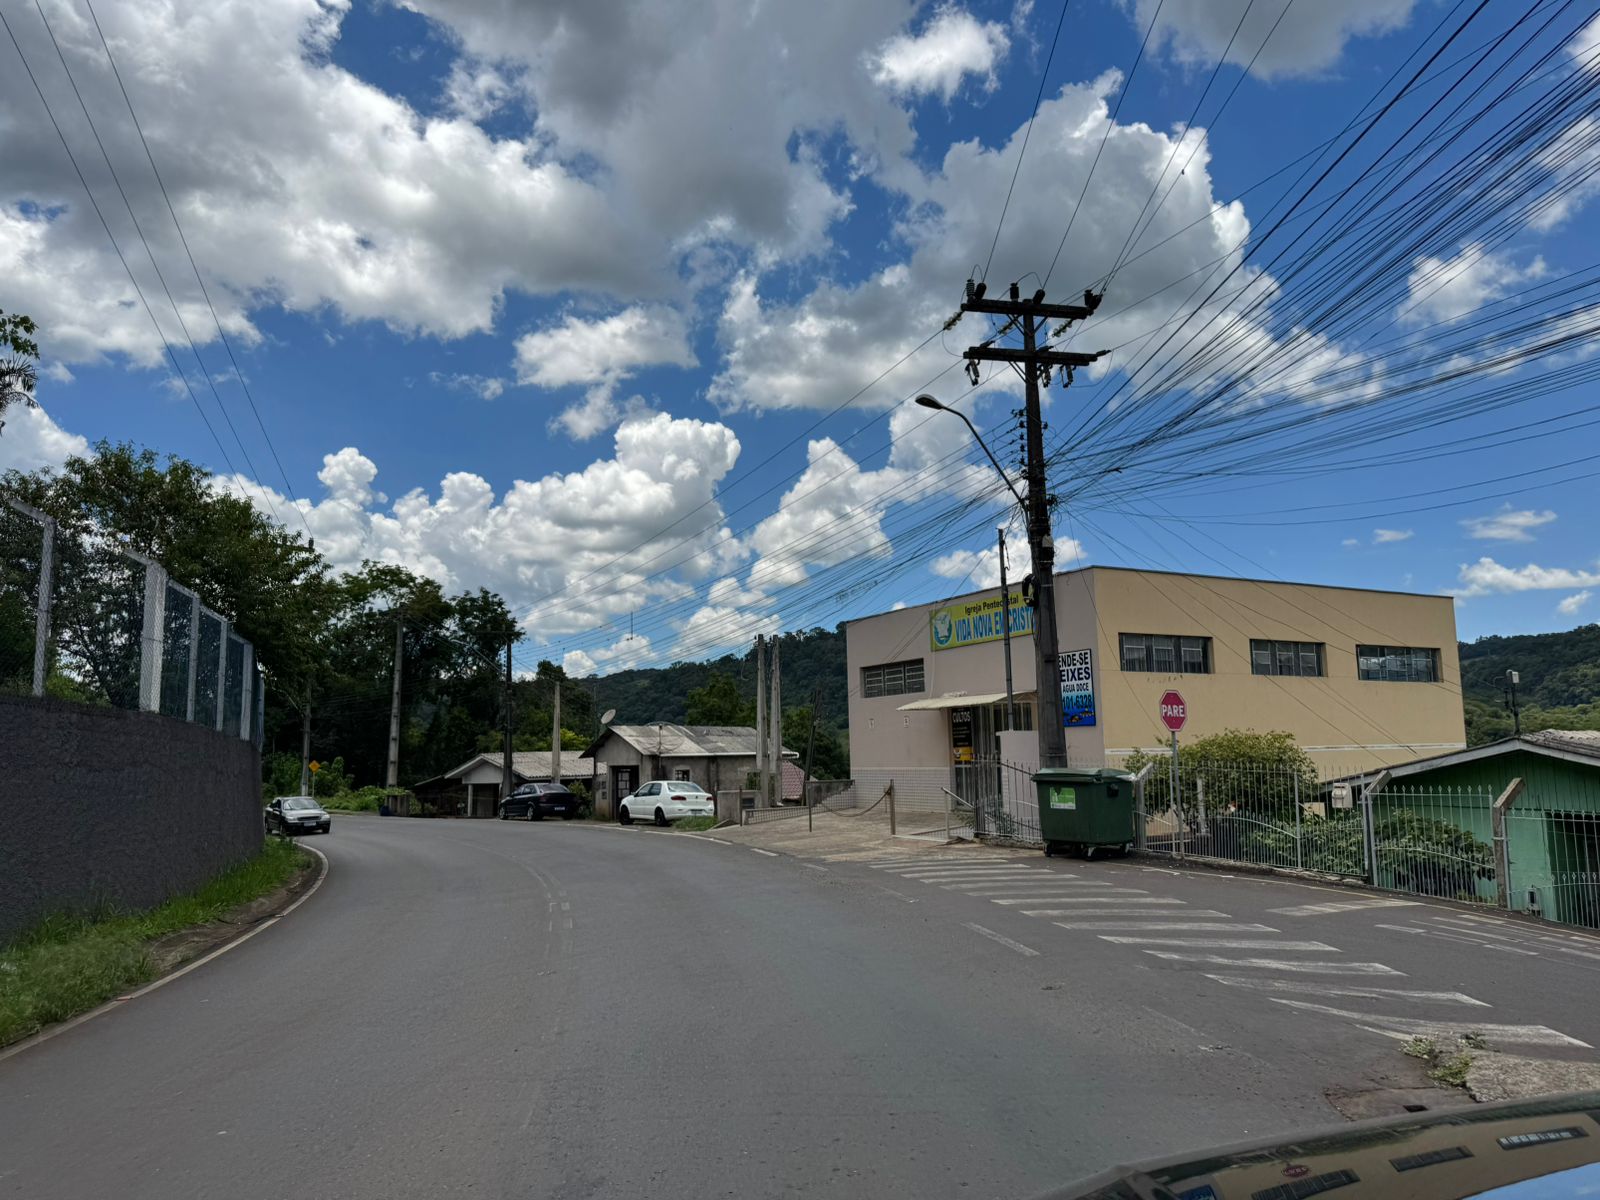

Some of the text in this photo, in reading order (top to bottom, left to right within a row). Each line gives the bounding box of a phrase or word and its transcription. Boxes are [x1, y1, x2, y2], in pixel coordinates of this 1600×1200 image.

[965, 595, 1019, 616] Igreja Pentecstal
[955, 616, 972, 642] VIDA
[973, 613, 993, 639] NOVA
[1060, 667, 1090, 682] EIXES
[1076, 682, 1089, 692] DOCE
[953, 711, 971, 723] CULTOS
[1162, 704, 1185, 717] PARE
